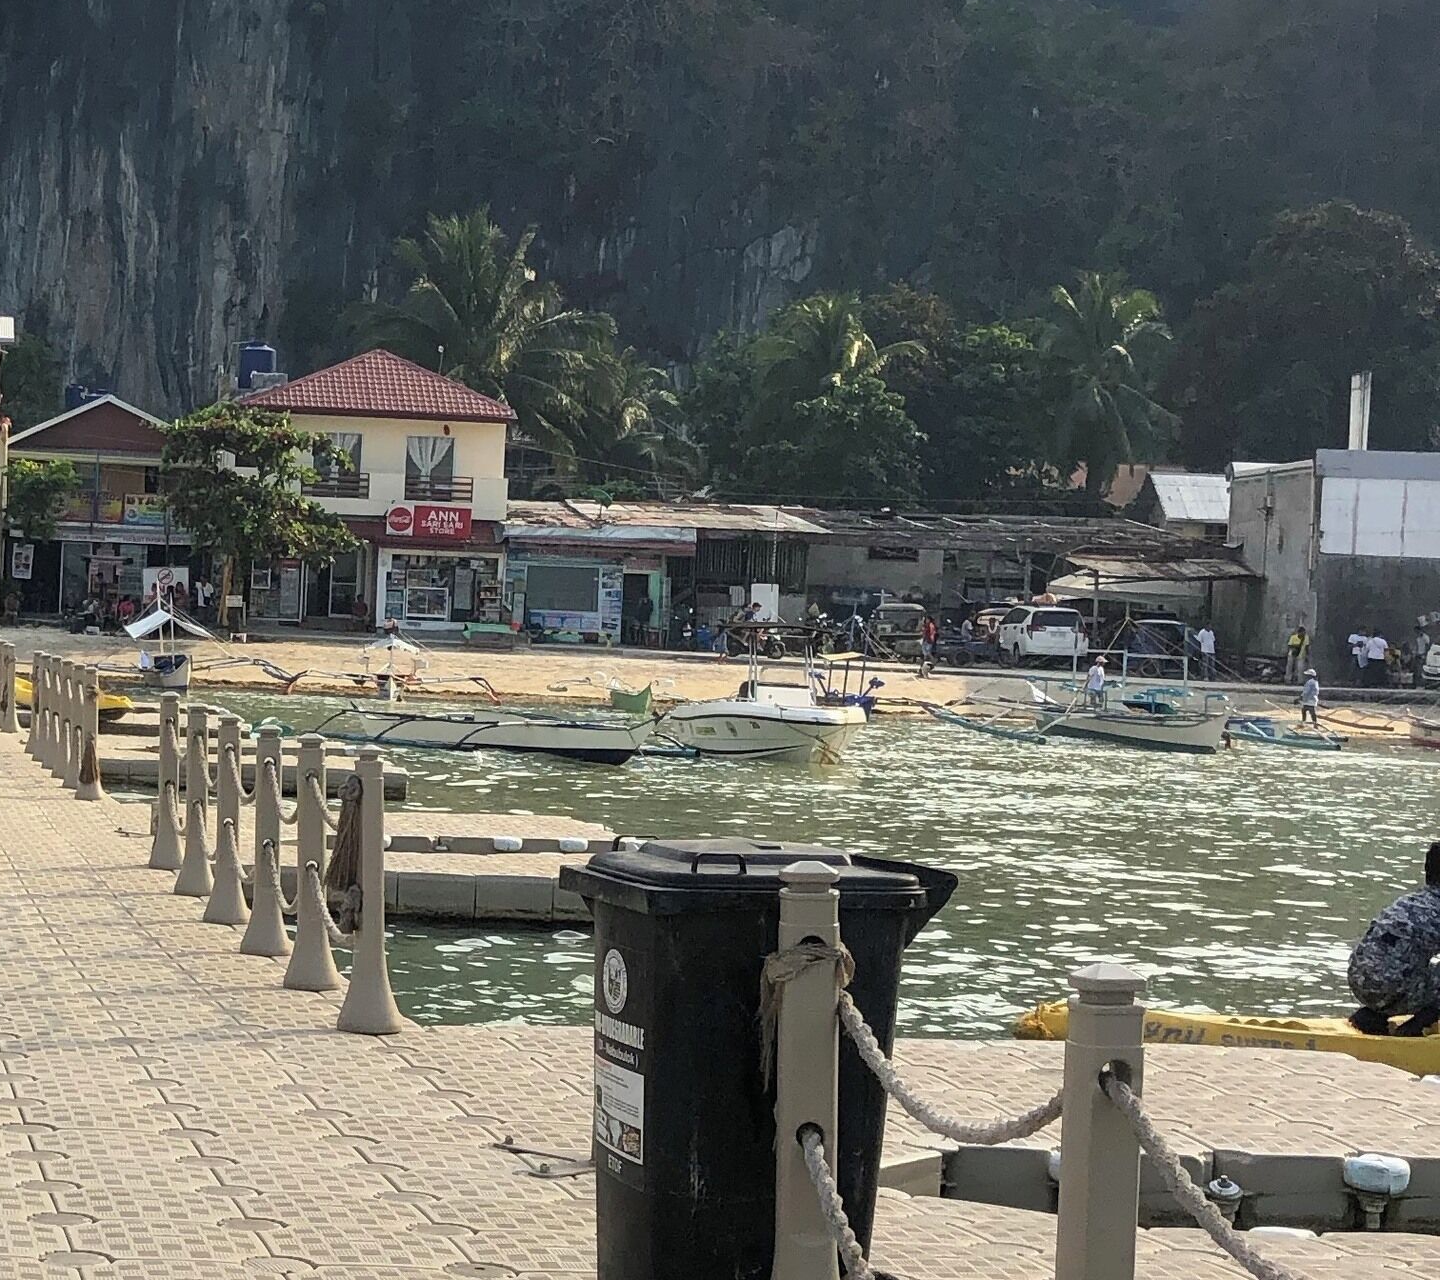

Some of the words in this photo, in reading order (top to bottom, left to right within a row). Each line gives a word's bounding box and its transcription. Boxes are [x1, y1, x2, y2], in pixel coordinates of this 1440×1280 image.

[427, 510, 459, 522] ANN
[421, 520, 441, 528] SARI
[443, 521, 463, 529] SARI
[429, 527, 455, 535] STORE
